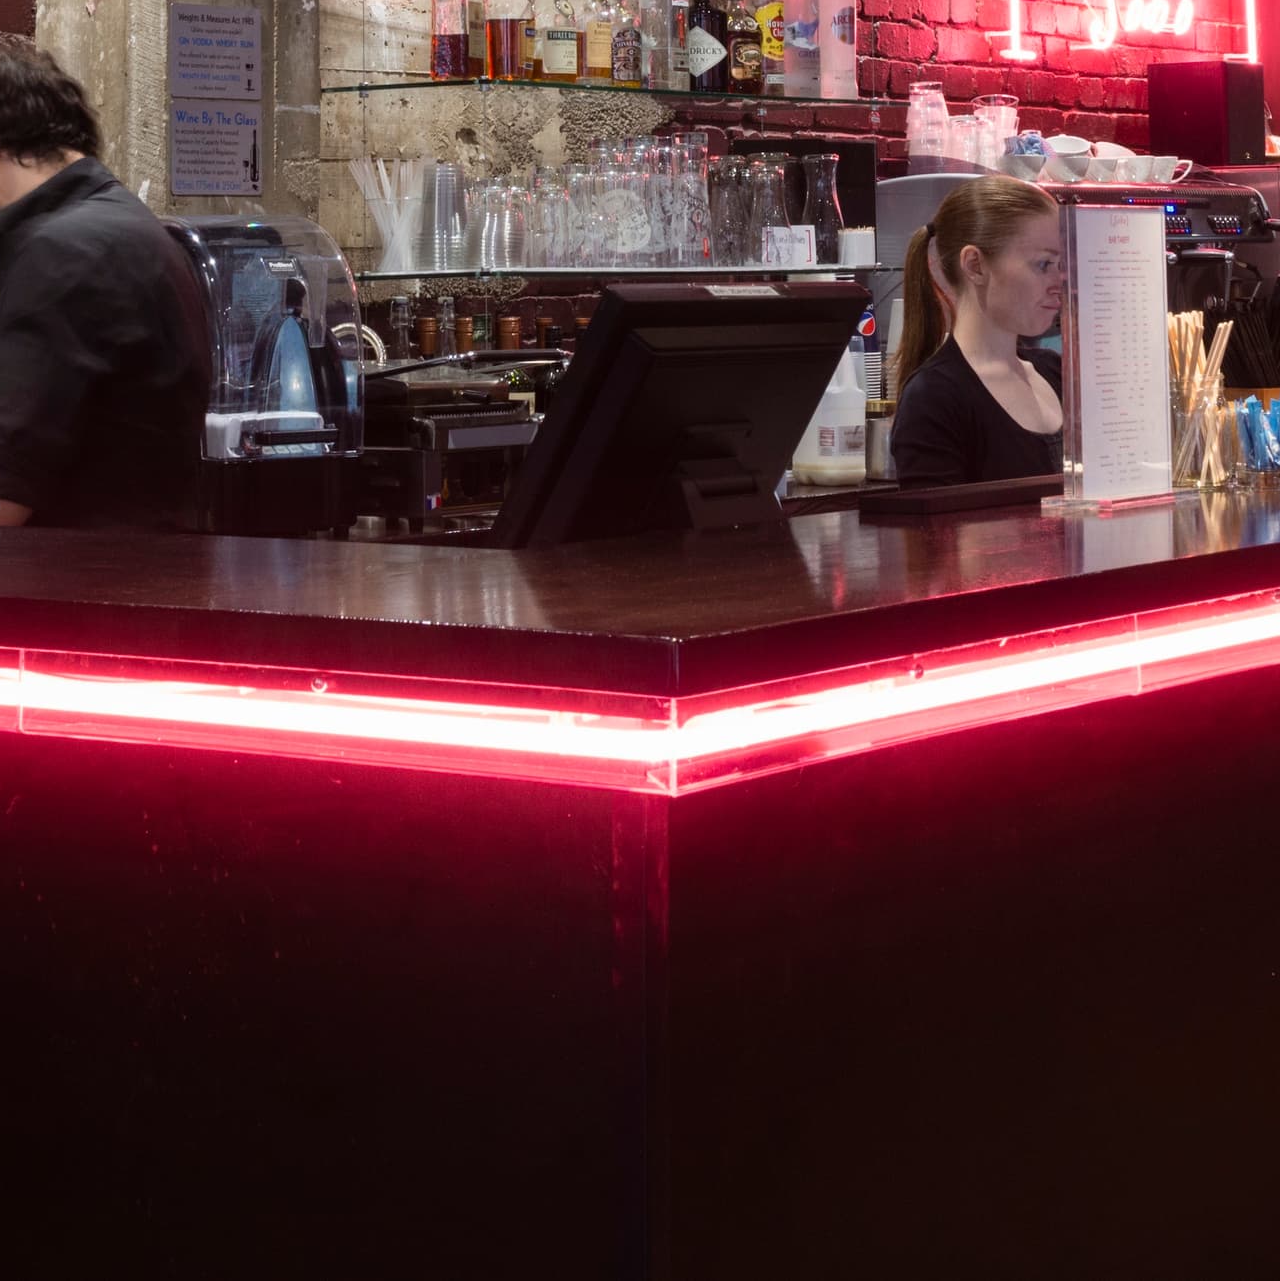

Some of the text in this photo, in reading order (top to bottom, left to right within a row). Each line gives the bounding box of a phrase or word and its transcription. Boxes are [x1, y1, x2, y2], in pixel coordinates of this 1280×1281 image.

[206, 14, 231, 24] Measures
[232, 16, 240, 24] Act
[192, 38, 214, 46] VODKA
[690, 47, 722, 56] DRICK'S
[176, 110, 257, 126] Wine By The Glass
